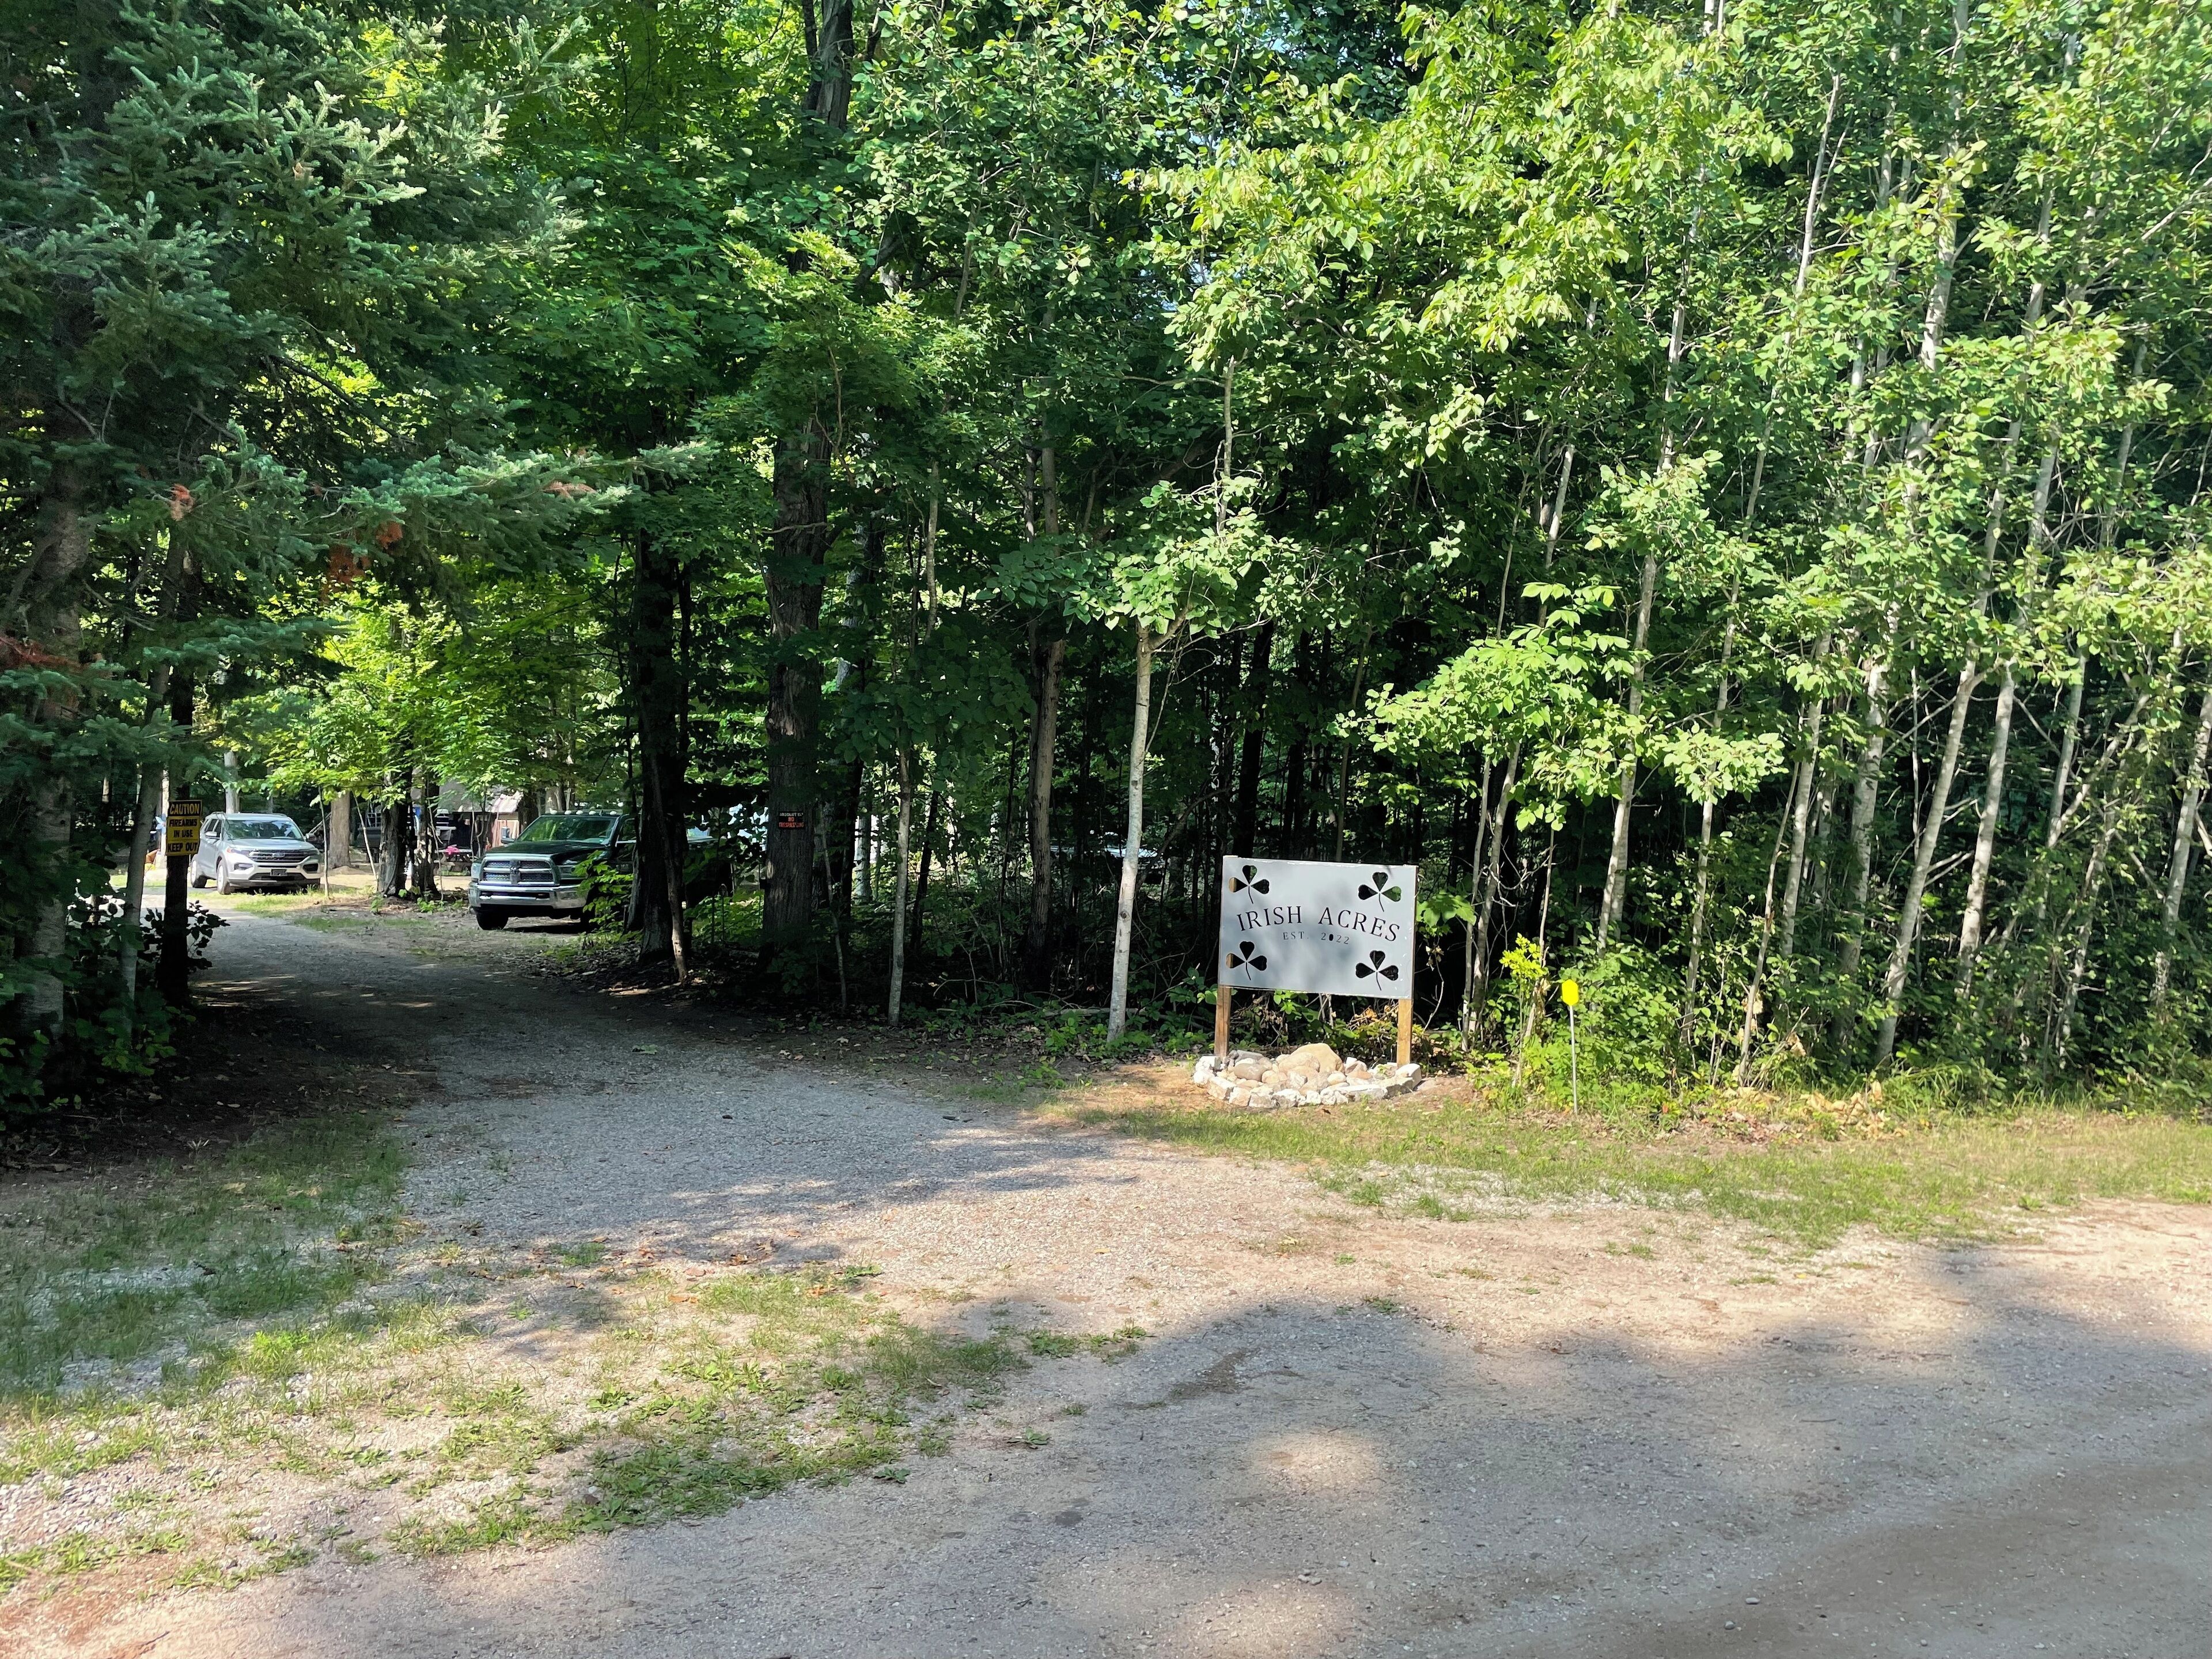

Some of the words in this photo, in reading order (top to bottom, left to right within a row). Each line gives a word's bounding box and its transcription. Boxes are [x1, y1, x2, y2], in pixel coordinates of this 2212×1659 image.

[170, 804, 199, 815] CAUTION
[182, 830, 193, 838] USE
[168, 843, 183, 852] KEEP
[185, 842, 198, 851] OUT
[1237, 906, 1302, 931] IRISH
[1318, 907, 1400, 942] ACRES
[1283, 931, 1309, 940] EST.
[1321, 932, 1350, 945] 2022
